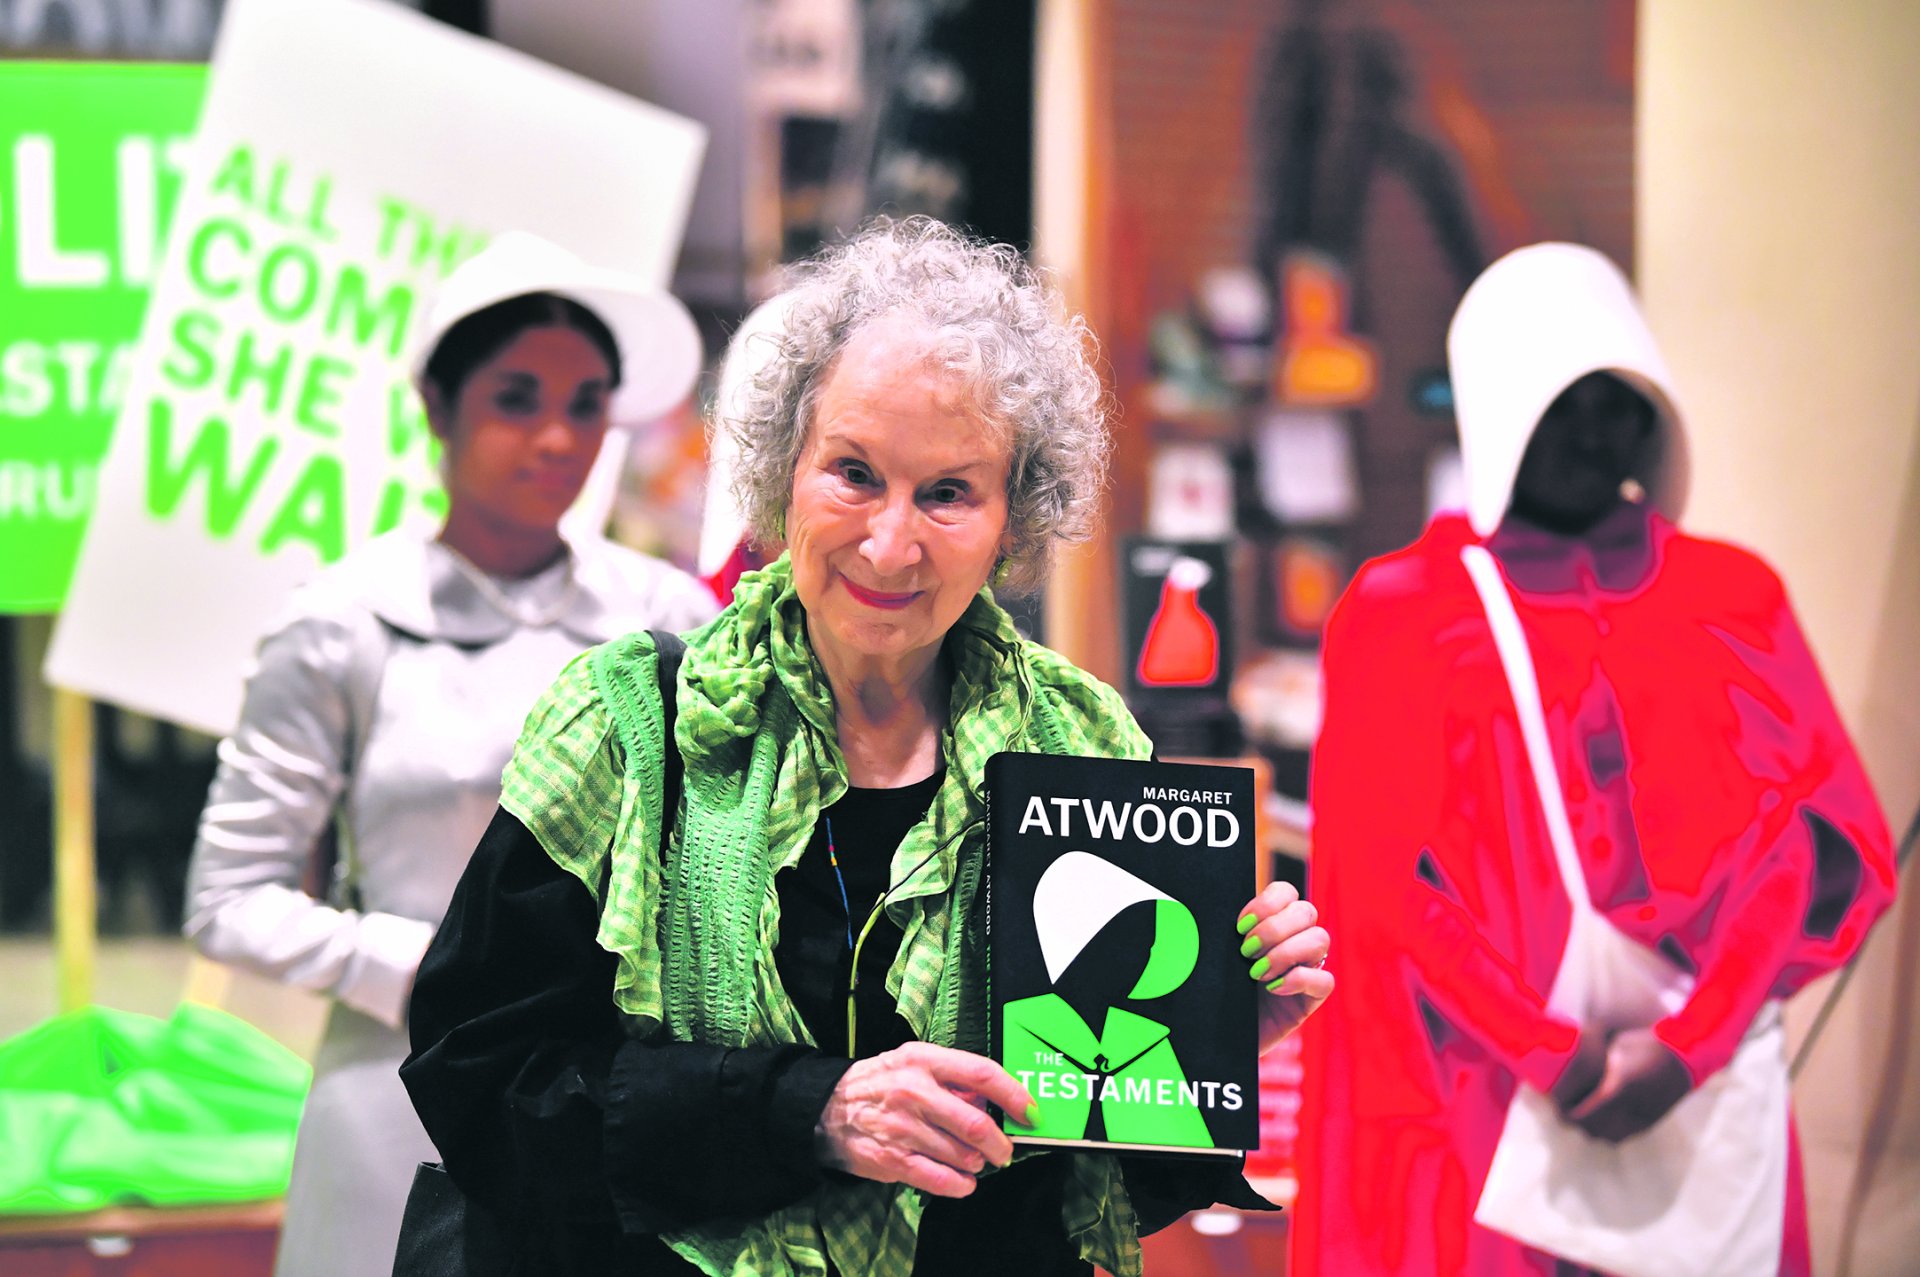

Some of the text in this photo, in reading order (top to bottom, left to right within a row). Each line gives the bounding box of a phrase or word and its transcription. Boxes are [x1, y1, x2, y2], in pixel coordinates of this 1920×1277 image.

[212, 144, 337, 241] ALL
[161, 311, 355, 438] SHE
[1143, 786, 1232, 805] MARGARET
[1018, 795, 1240, 848] ATWOOD
[1034, 1051, 1064, 1066] THE
[1016, 1070, 1243, 1110] TESTAMENTS
